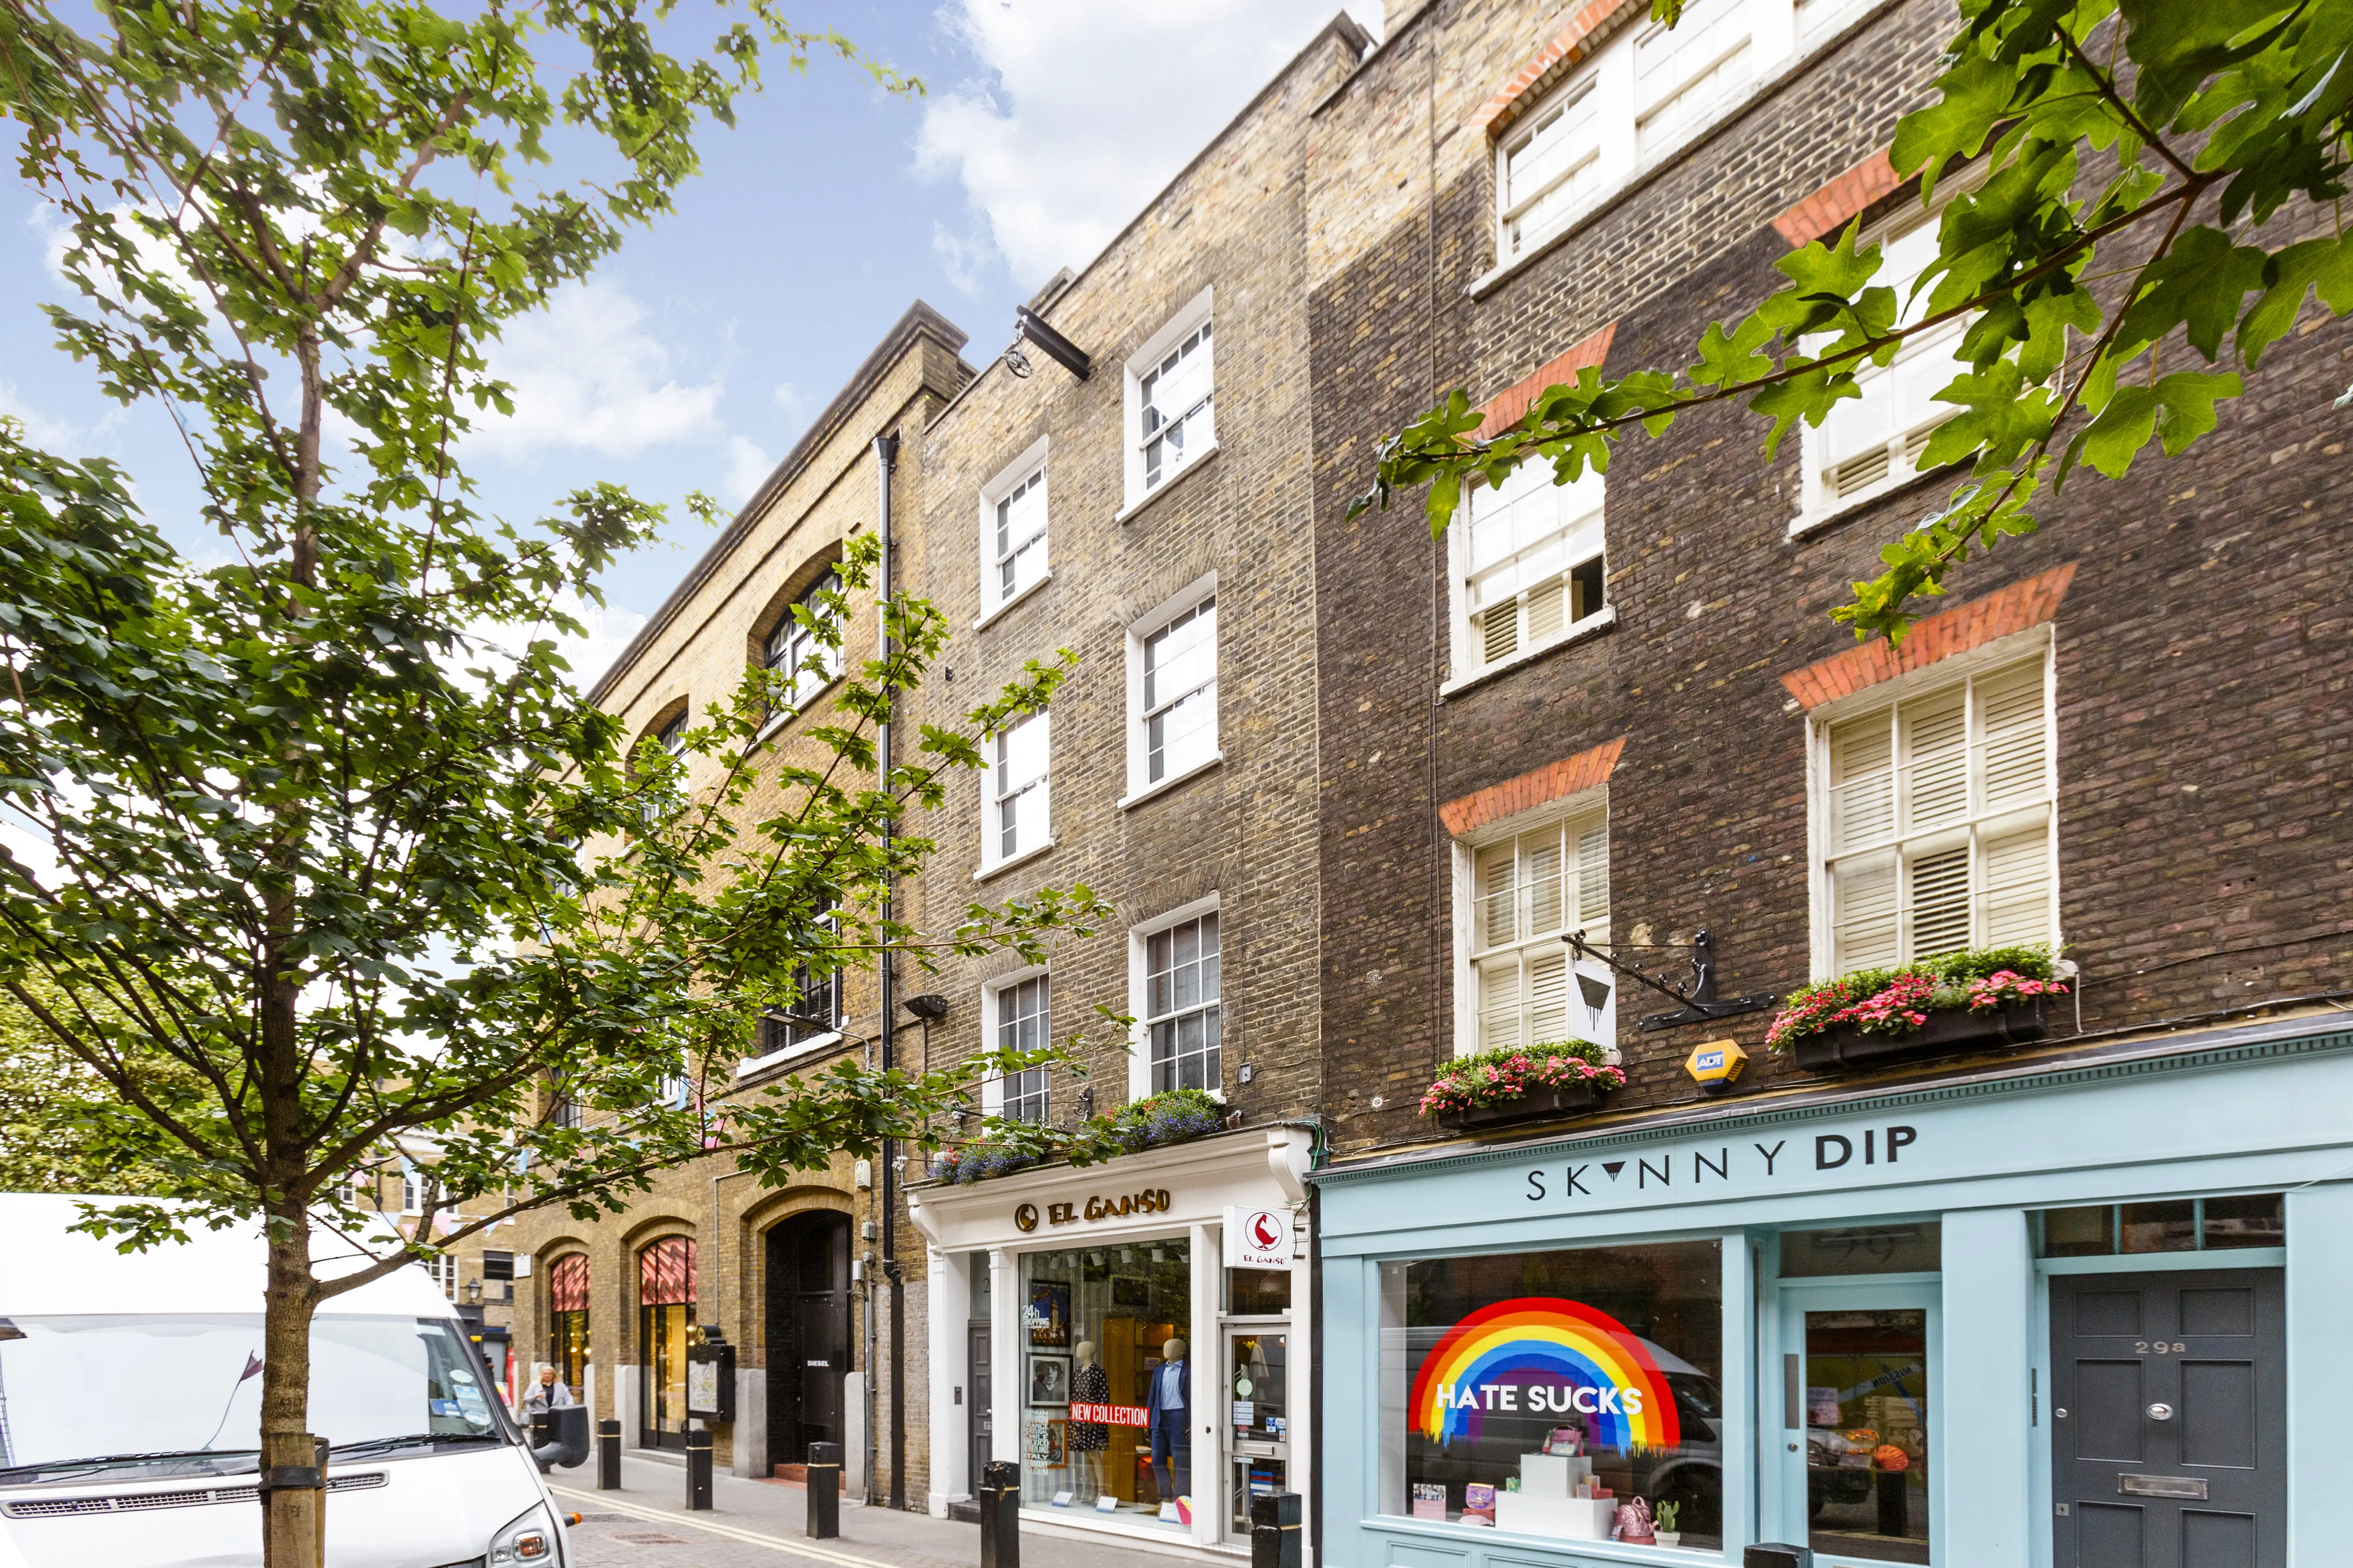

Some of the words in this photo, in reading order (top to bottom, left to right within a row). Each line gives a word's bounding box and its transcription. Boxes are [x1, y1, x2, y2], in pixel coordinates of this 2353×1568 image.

[1697, 1054, 1724, 1068] ADT
[1815, 1126, 1917, 1170] DIP
[1047, 1203, 1078, 1225] EL
[1084, 1189, 1171, 1220] GANSO
[1257, 1256, 1285, 1265] GANSO
[1022, 1317, 1049, 1326] SHOPPING
[2135, 1342, 2186, 1354] 29a
[1437, 1384, 1518, 1410] HATE
[1528, 1386, 1642, 1415] SUCKS
[1072, 1404, 1091, 1420] NEW
[1093, 1405, 1147, 1426] COLLECTION
